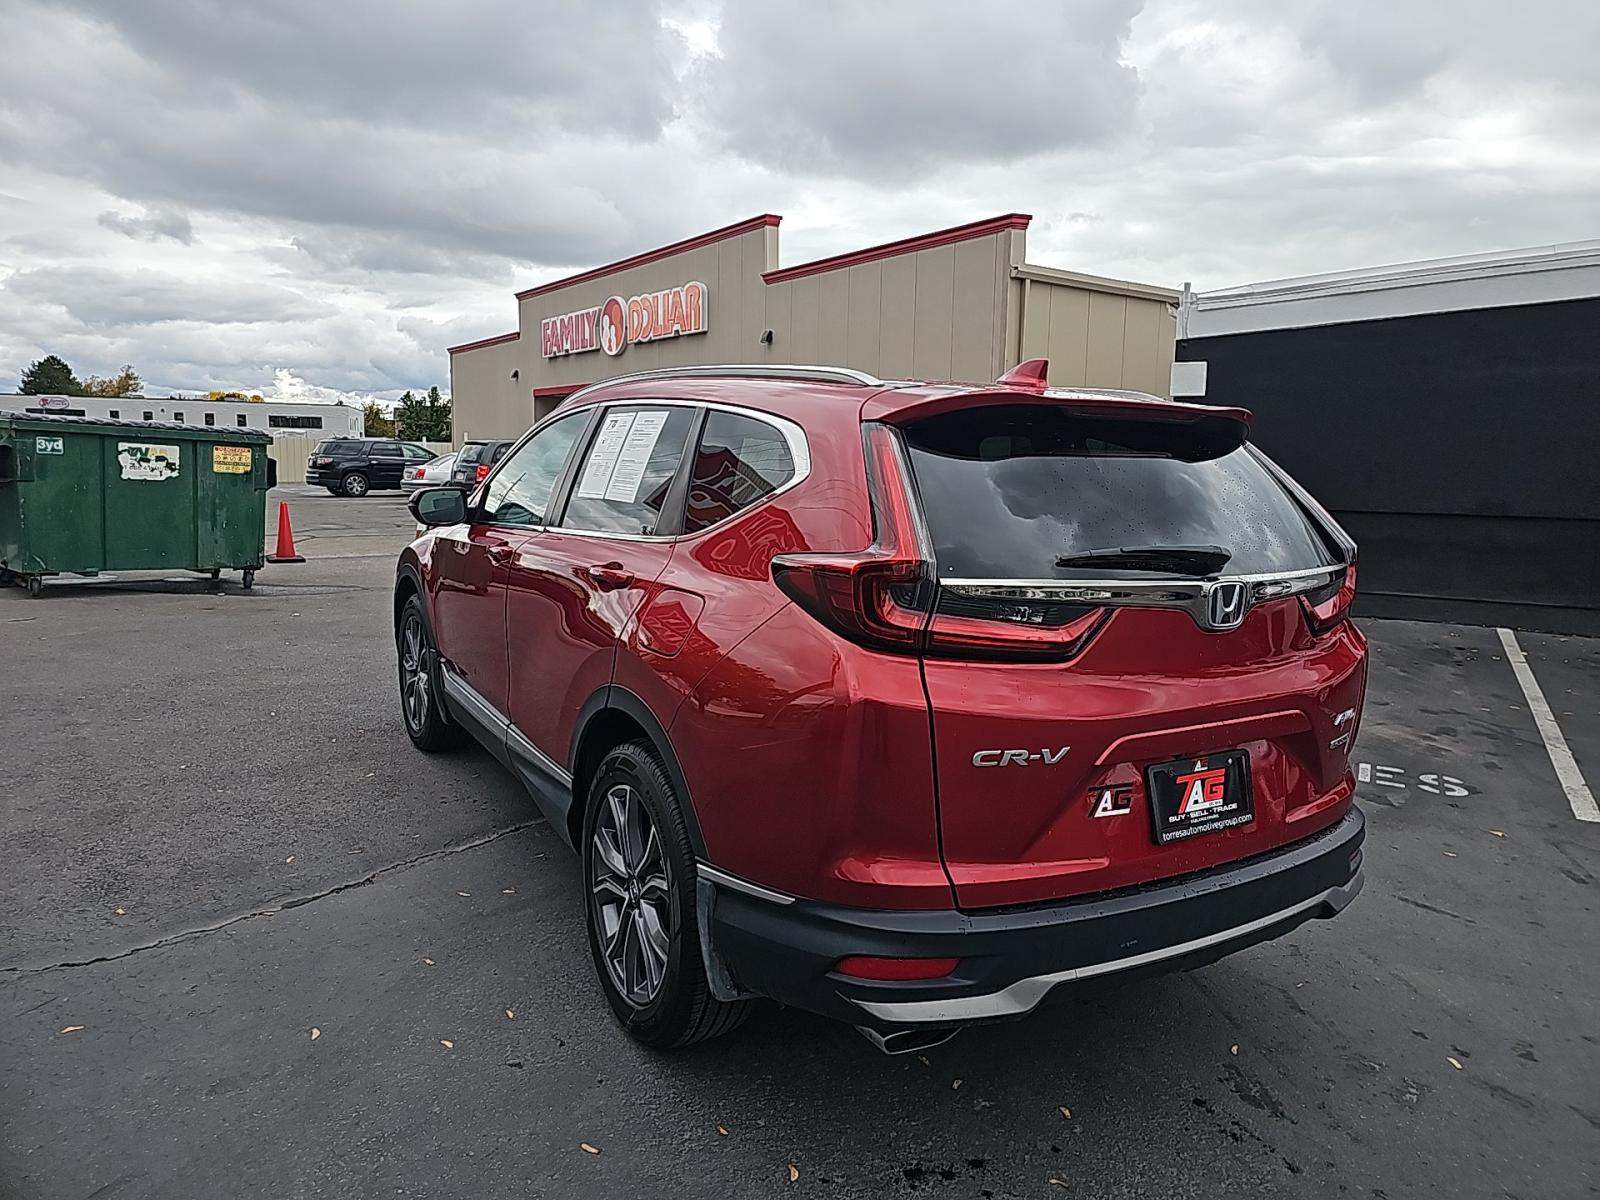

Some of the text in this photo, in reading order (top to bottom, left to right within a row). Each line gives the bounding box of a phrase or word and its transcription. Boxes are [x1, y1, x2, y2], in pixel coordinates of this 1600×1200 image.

[542, 283, 703, 357] FAMILY DOLLAR
[37, 439, 63, 452] 3yd
[972, 746, 1071, 767] CR-V
[1087, 782, 1133, 818] TAG
[1176, 768, 1226, 814] TAG
[1168, 813, 1186, 823] BUY
[1189, 809, 1209, 819] SELL
[1212, 803, 1238, 813] TRADE
[1162, 814, 1253, 842] torresautomotivegroup.com
